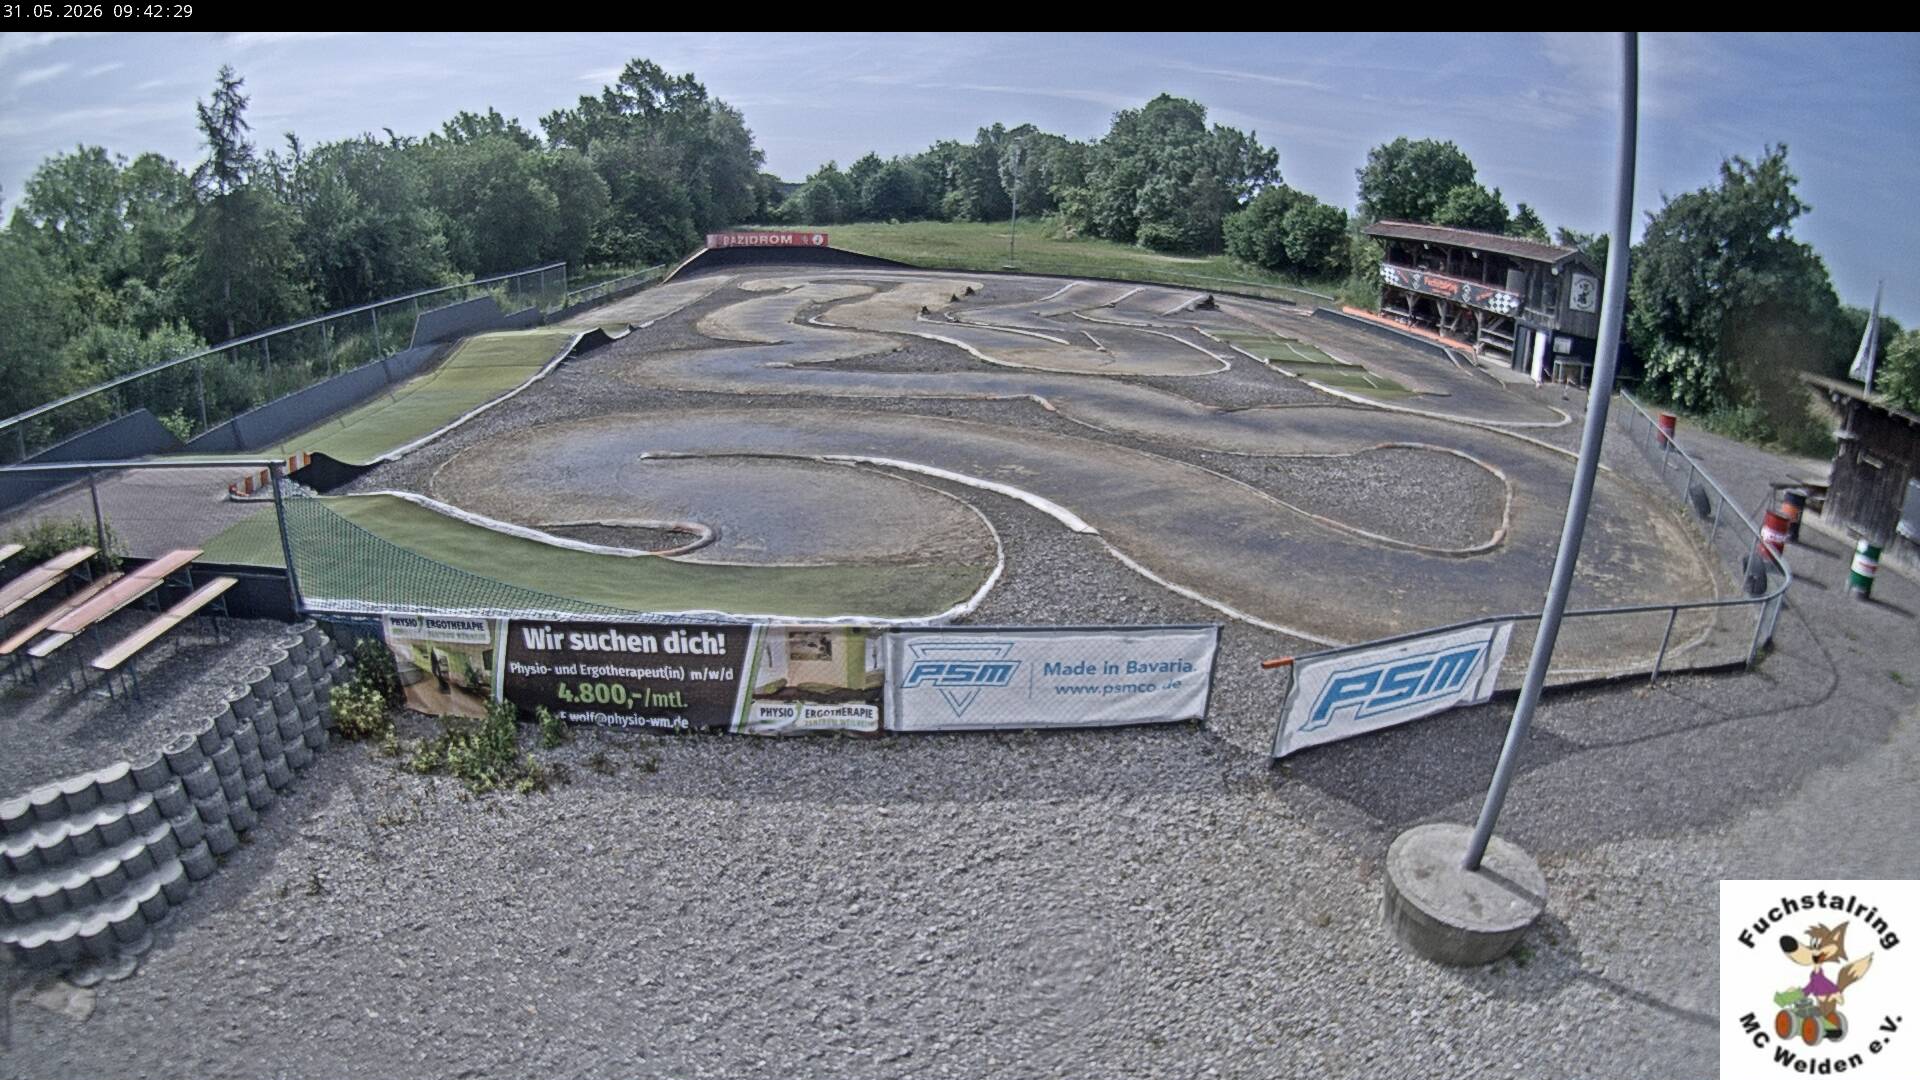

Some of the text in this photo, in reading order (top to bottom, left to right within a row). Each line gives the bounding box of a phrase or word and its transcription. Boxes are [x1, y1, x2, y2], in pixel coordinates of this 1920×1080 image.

[390, 617, 485, 632] PHYSIO ERGOTHERAPIE
[522, 626, 727, 655] Wir suchen dich!
[510, 661, 734, 681] Physio- und Ergotherapeut(in) m/w/d
[905, 663, 1016, 685] PSM
[1043, 661, 1097, 677] Made
[1103, 660, 1119, 675] in
[1308, 646, 1485, 725] PSM
[760, 707, 873, 719] PHYSIO ERGOTHERAPIE
